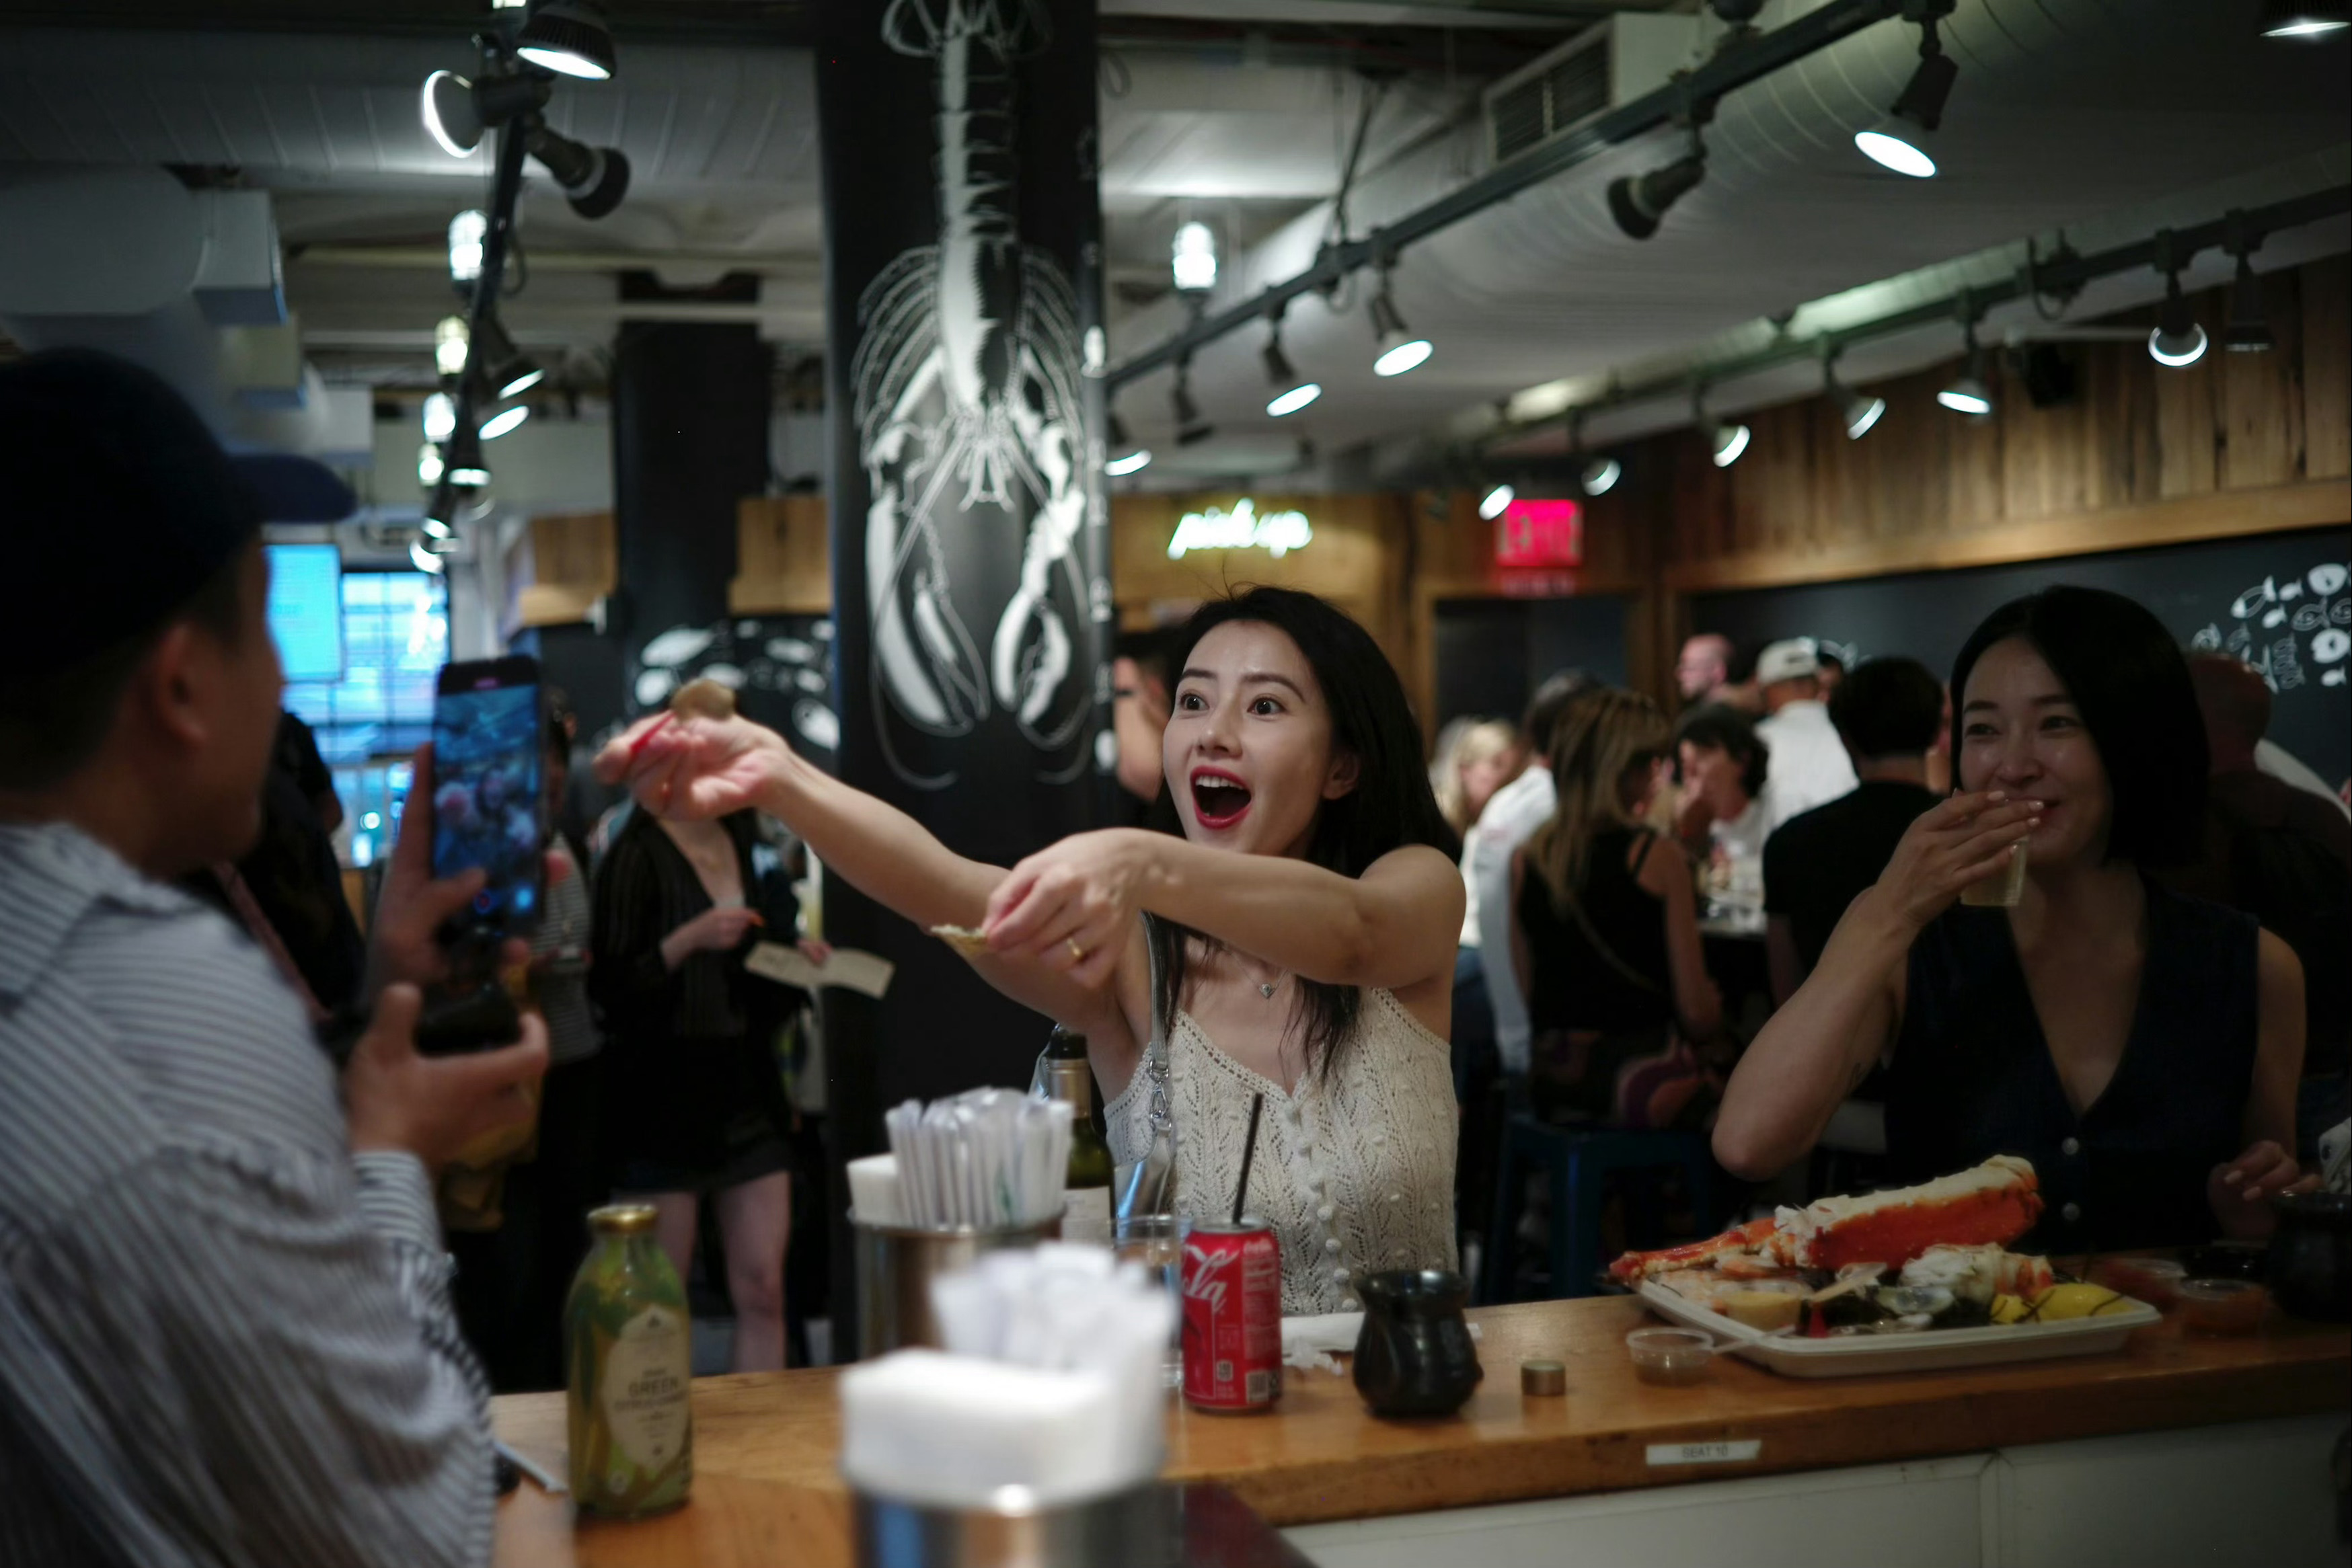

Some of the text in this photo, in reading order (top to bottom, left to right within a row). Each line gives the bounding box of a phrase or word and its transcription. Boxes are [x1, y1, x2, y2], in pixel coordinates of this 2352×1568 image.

[628, 1376, 678, 1397] GREEN
[1682, 1446, 1729, 1458] SEAT 10
